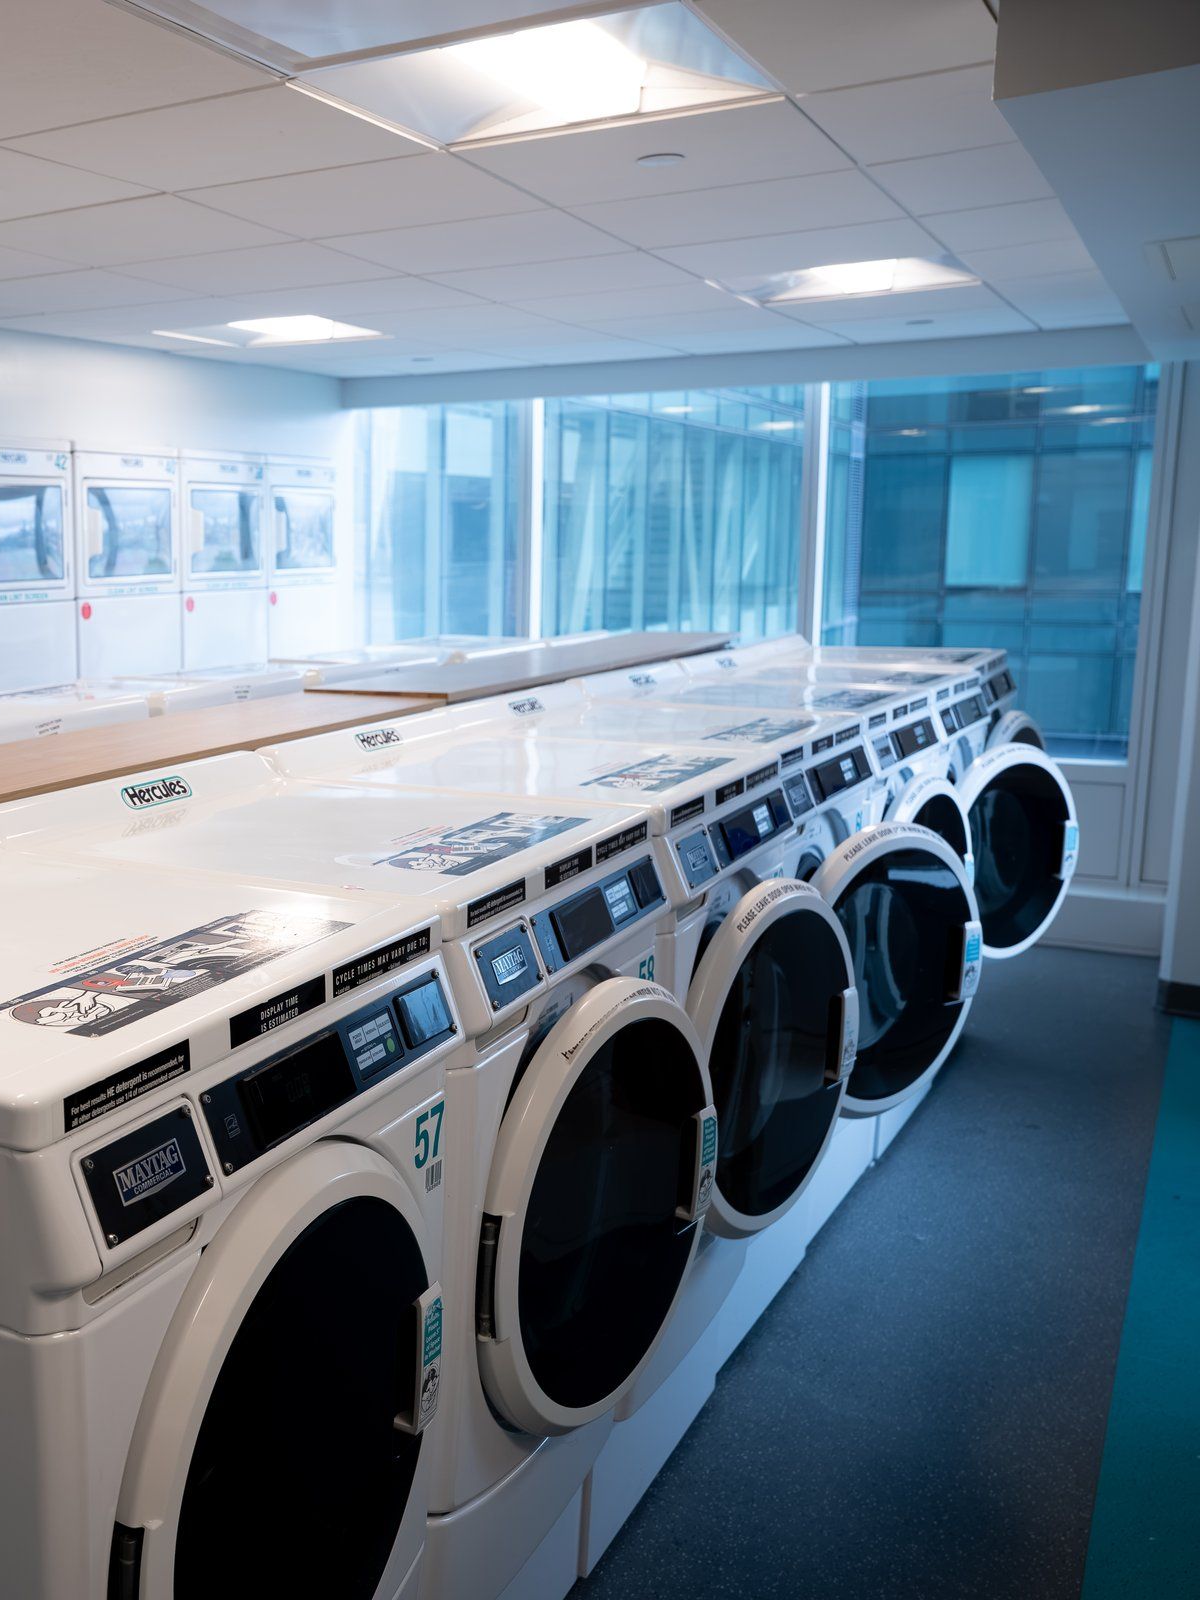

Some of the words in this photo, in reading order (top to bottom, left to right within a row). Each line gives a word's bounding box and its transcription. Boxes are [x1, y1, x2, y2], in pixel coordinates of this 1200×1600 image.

[358, 730, 400, 749] Hercules
[124, 779, 188, 806] Hercules
[843, 843, 864, 862] PLEASE
[737, 909, 757, 933] PLEASE
[754, 896, 771, 914] LEAVE
[335, 968, 355, 986] CYCLE
[357, 959, 376, 975] TIMES
[377, 952, 390, 966] MAY
[391, 945, 406, 960] VARY
[493, 948, 524, 975] MAYTAG
[261, 1002, 283, 1021] DISPLAY
[285, 994, 299, 1008] TIME
[261, 1022, 267, 1033] IS
[269, 1007, 299, 1029] ESTIMATED
[71, 1107, 79, 1116] For
[80, 1099, 91, 1111] best
[90, 1092, 106, 1105] results
[106, 1086, 115, 1098] HE
[115, 1073, 142, 1094] detergent
[78, 1112, 92, 1125] other
[91, 1101, 116, 1118] detergents
[116, 1096, 125, 1105] use
[414, 1100, 445, 1169] 57
[118, 1144, 179, 1193] MAYTAG
[133, 1168, 174, 1194] COMMERCIAL
